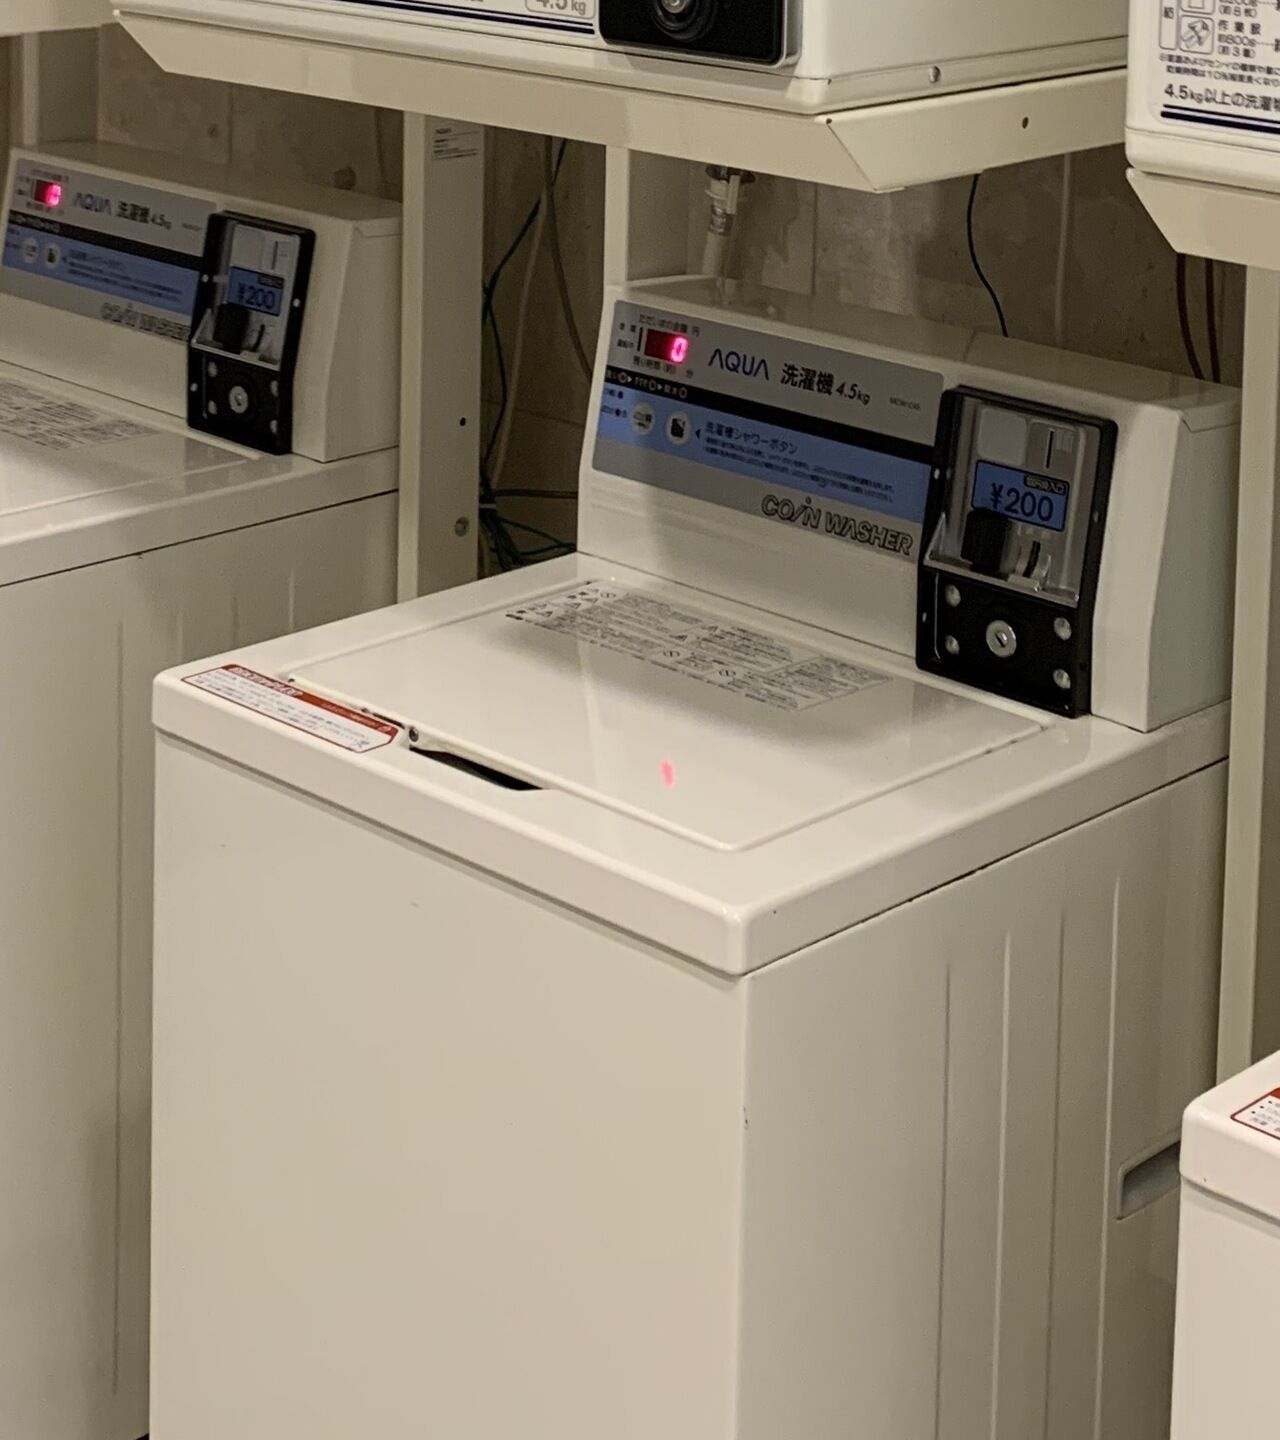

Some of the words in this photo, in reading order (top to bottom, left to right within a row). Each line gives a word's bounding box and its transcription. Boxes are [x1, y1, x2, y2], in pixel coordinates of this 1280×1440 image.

[237, 281, 276, 310] ¥200
[708, 348, 770, 381] AQUA
[780, 363, 835, 396] 洗濯機
[836, 381, 871, 406] 4.5kg
[990, 481, 1054, 523] ¥200
[824, 510, 914, 557] WASHER
